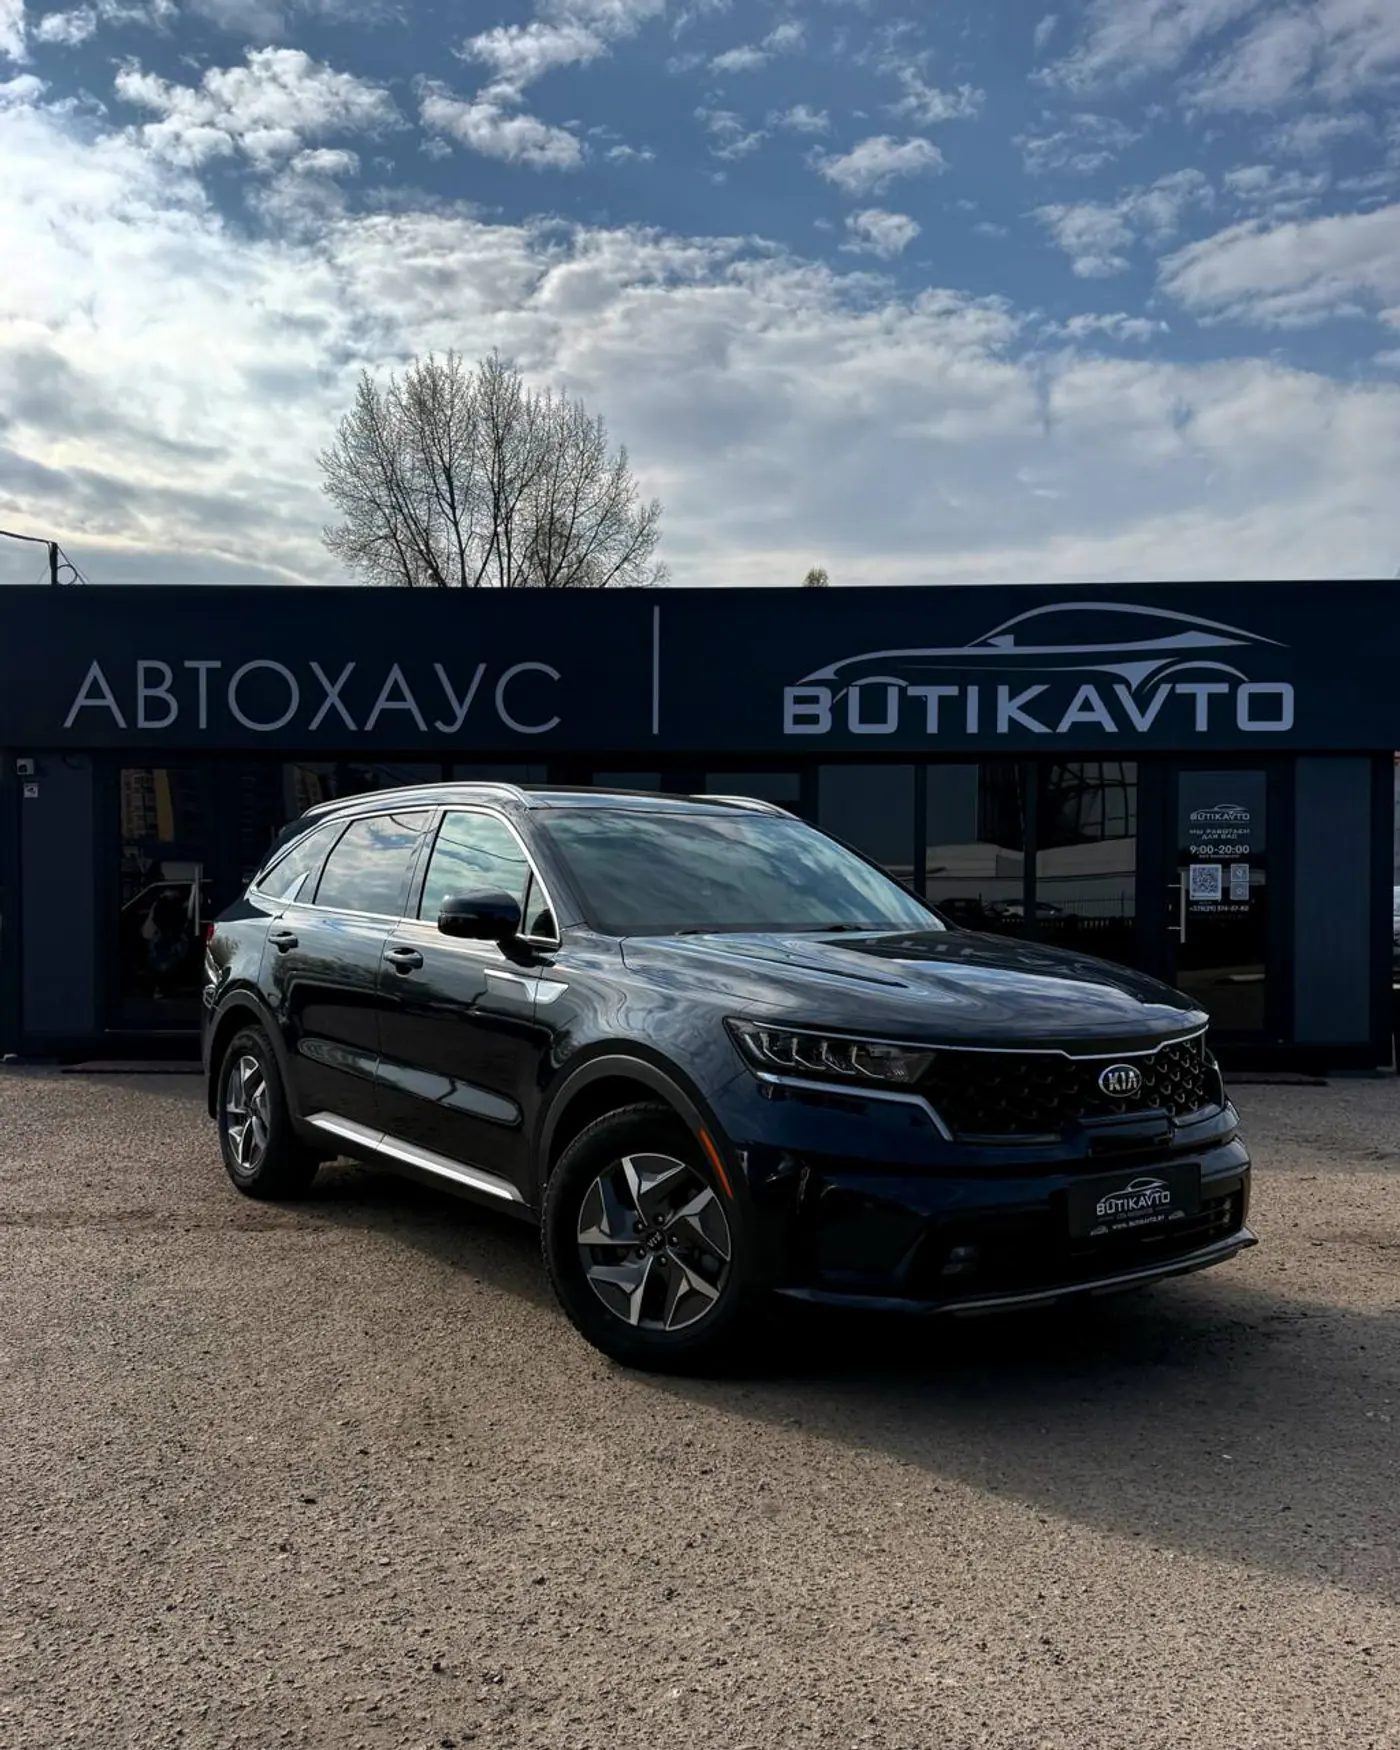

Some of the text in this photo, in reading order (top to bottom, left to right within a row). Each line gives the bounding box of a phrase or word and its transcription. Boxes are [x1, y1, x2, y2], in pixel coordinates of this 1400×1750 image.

[62, 659, 561, 734] АВТОХАУС
[782, 682, 1295, 735] BUTIKAVTO
[1190, 813, 1250, 821] BUTIKAVTO
[1189, 844, 1250, 854] 9:00-20:00
[1107, 1071, 1138, 1091] KIA
[1096, 1191, 1170, 1215] BUTIKAVTO
